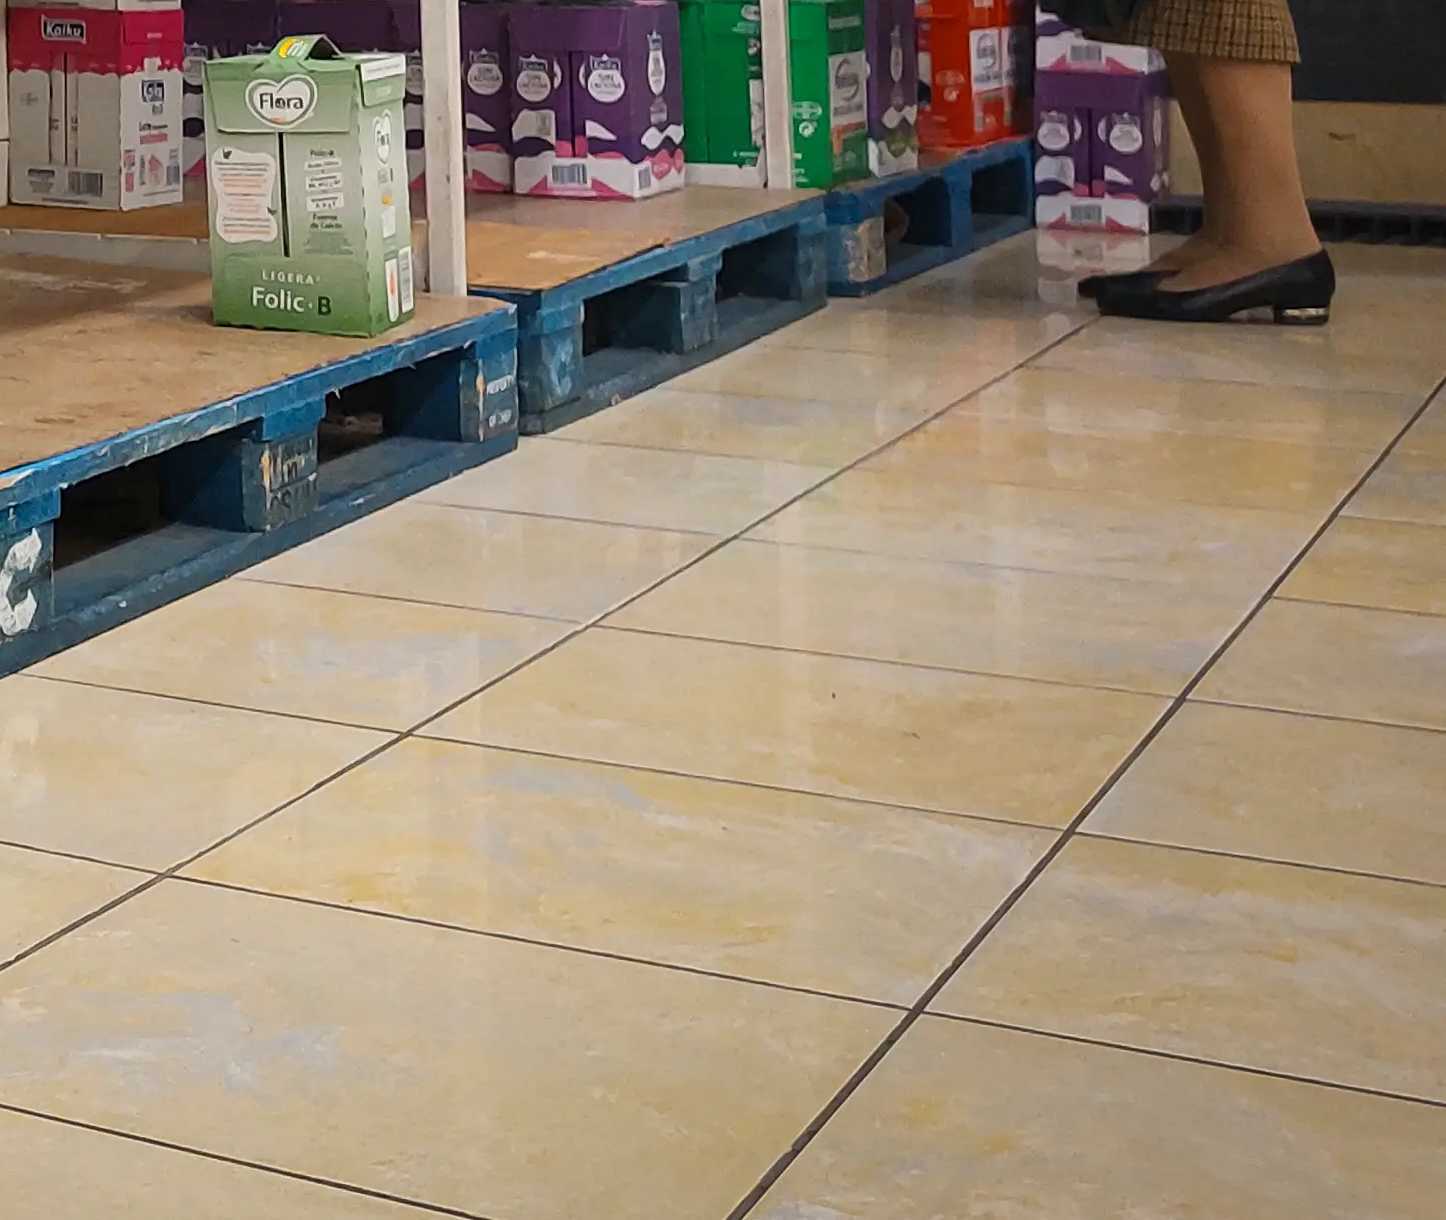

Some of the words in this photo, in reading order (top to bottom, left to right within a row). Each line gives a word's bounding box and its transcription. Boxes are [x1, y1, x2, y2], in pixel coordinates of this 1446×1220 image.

[43, 19, 84, 39] Kaiku
[259, 93, 304, 111] Flora
[262, 270, 314, 285] LIGERA
[252, 287, 304, 313] Folic
